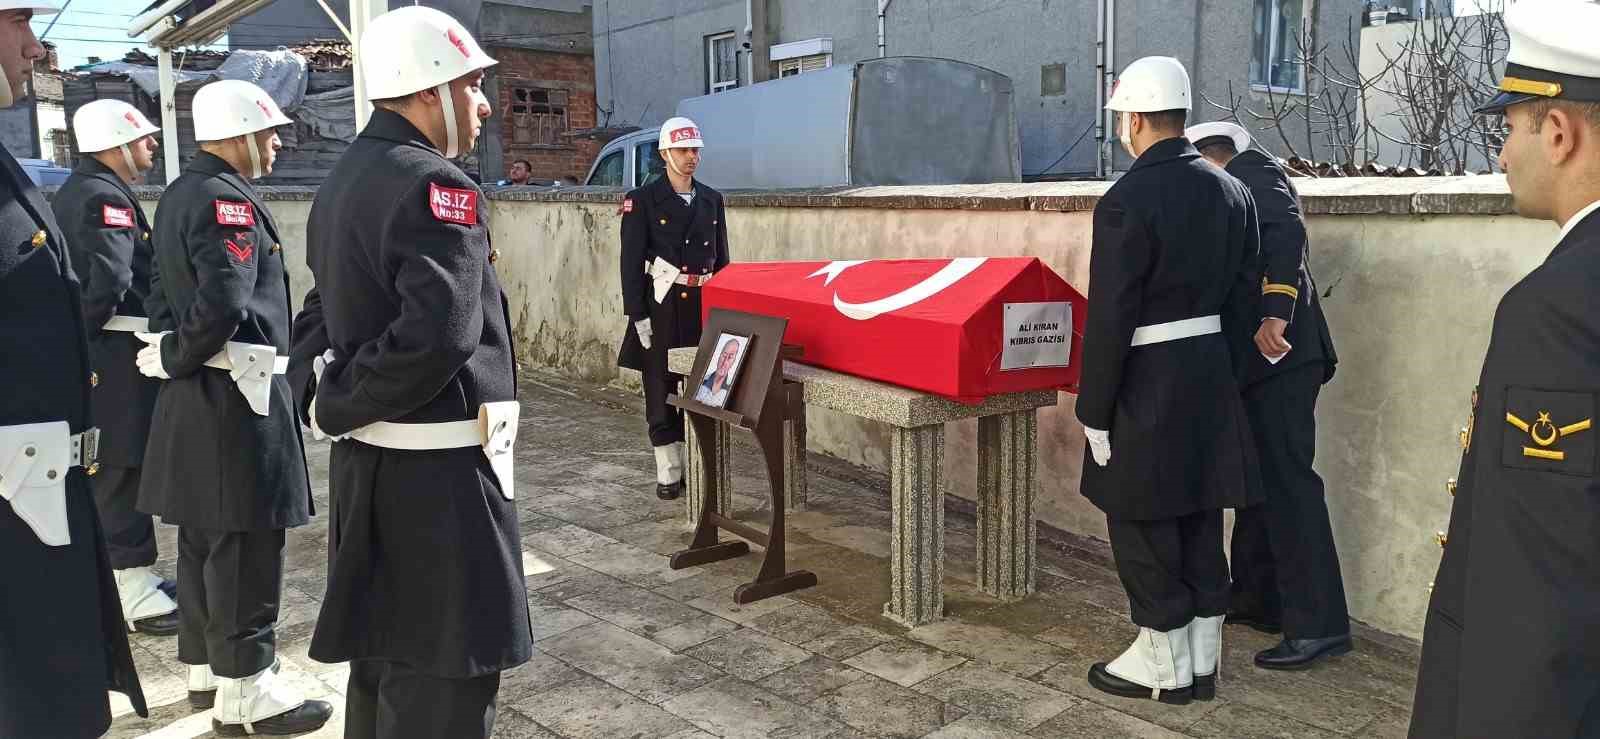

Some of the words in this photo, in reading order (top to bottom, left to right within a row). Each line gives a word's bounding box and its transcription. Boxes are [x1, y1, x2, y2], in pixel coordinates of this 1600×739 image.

[440, 206, 465, 220] No:33
[1033, 322, 1058, 332] KIRAN
[1010, 336, 1036, 346] KIBRIS
